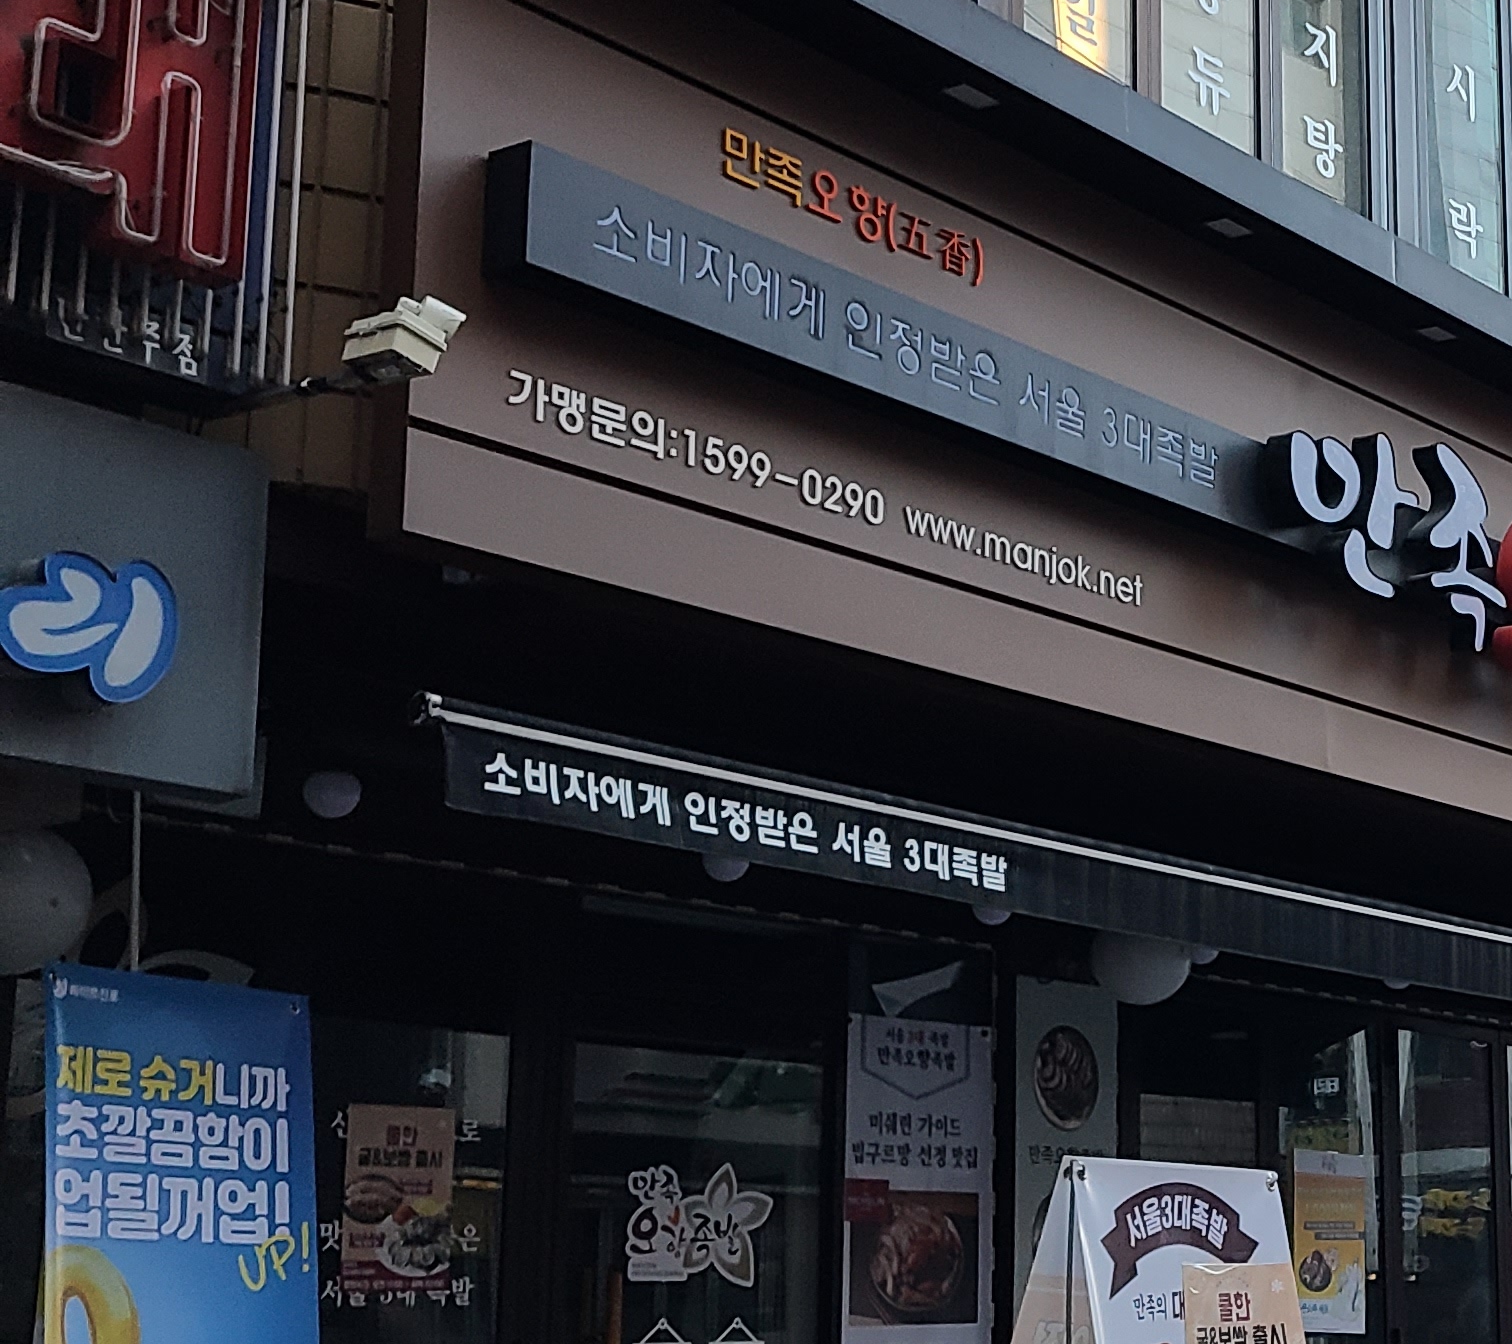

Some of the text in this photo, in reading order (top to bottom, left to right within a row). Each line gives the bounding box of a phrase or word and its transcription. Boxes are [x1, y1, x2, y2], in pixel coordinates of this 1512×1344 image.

[721, 127, 986, 288] 만족오향(五香)
[592, 204, 1221, 491] 소비자에게 인정받은 서울 3대족발
[506, 368, 1145, 608] 가맹문의:1599-0290 www.manjok.net
[484, 752, 1008, 893] 소비자에게 인정받은 서울 3대족발
[56, 1045, 290, 1112] 제로 슈거니까
[55, 1100, 290, 1173] 초깔끔함이
[918, 1115, 962, 1138] 가이드
[920, 1144, 949, 1168] 선정
[952, 1145, 979, 1170] 맛집
[54, 1166, 291, 1246] 업될꺼업!
[632, 1169, 678, 1204] 만족
[690, 1212, 740, 1257] 족발
[1125, 1194, 1230, 1250] 서울3대족발
[238, 1221, 311, 1292] UP!
[1132, 1293, 1168, 1323] 만족의
[1217, 1291, 1251, 1324] 쿨한
